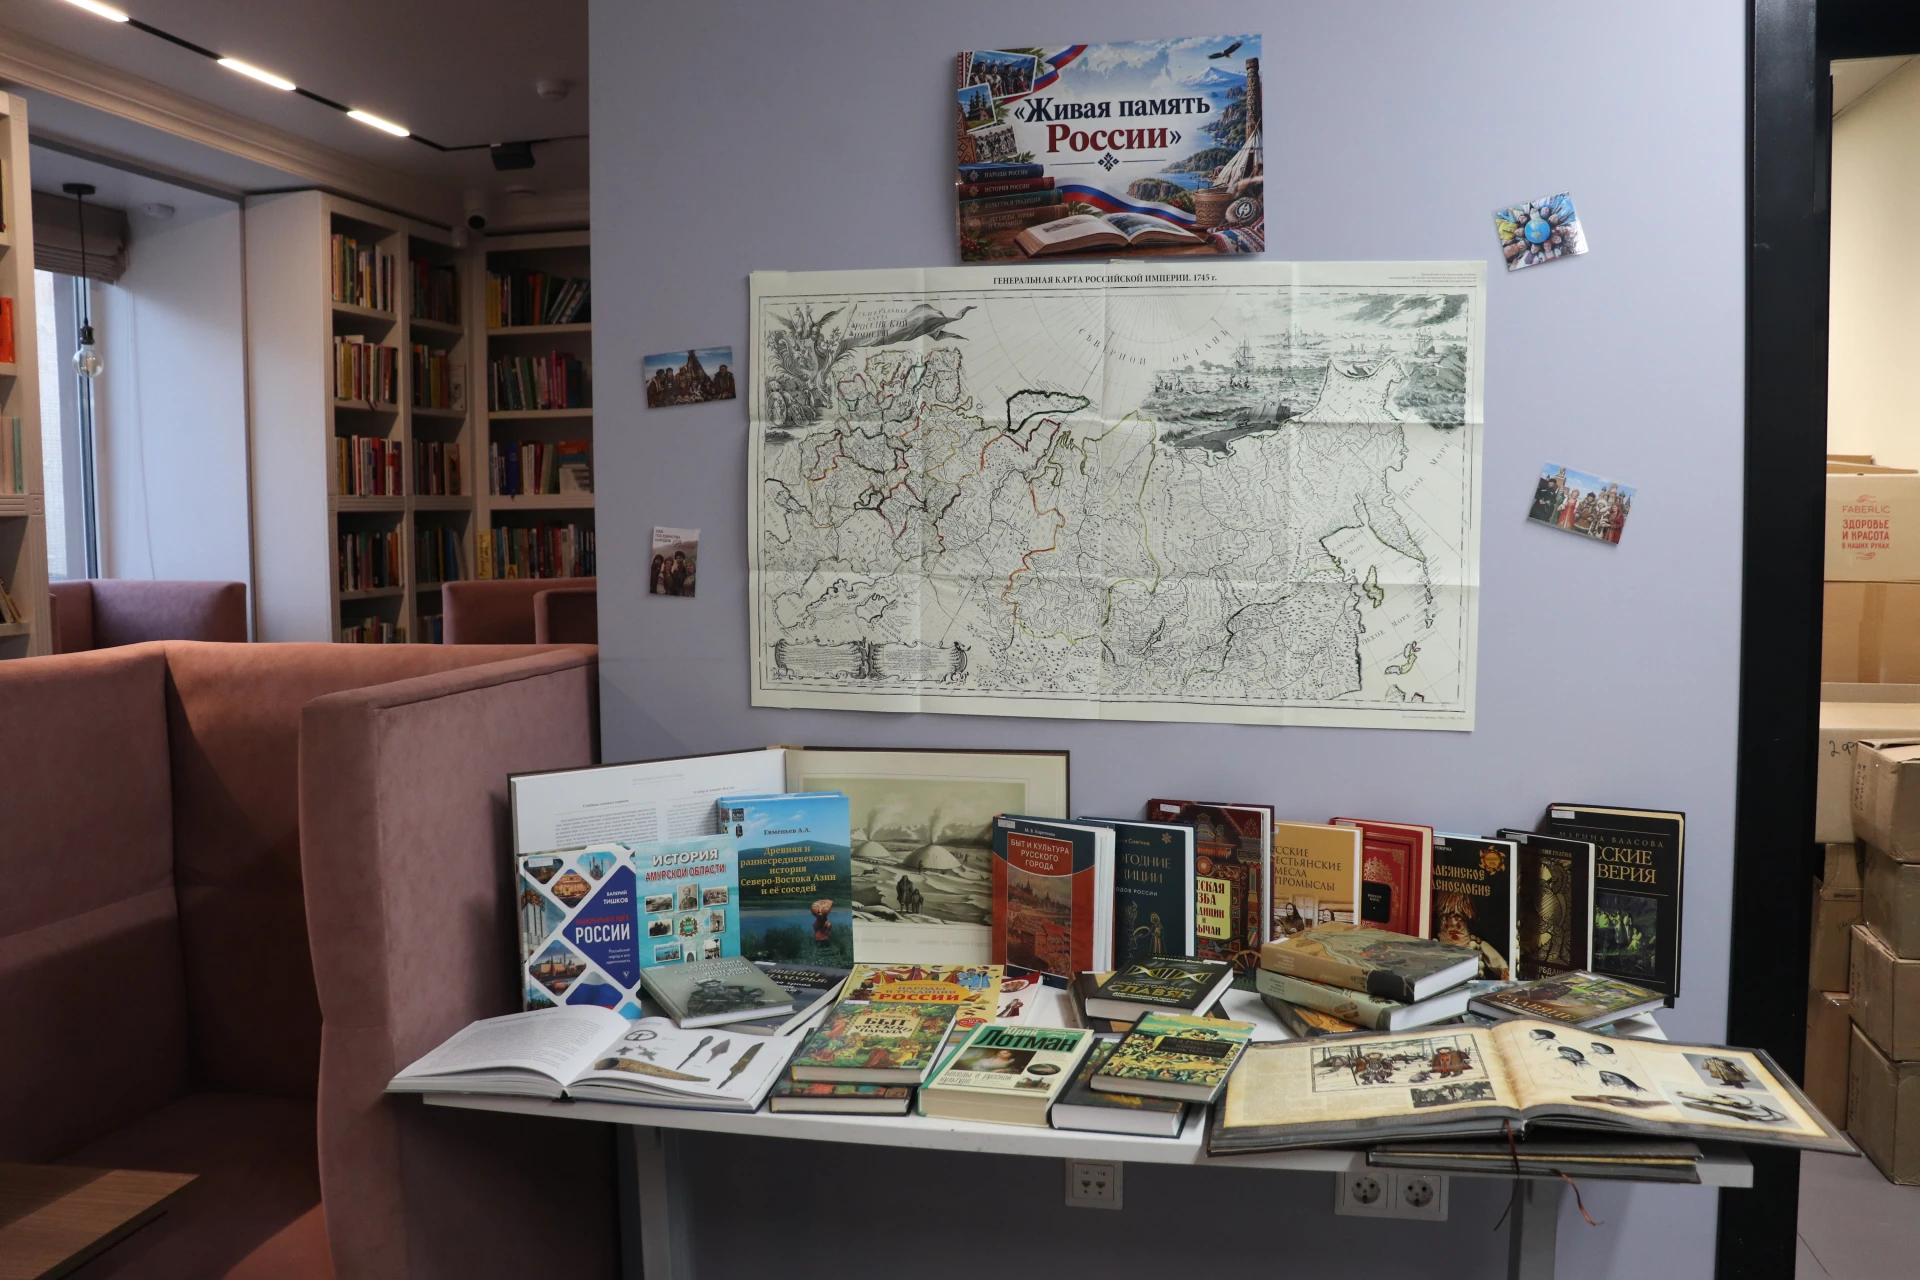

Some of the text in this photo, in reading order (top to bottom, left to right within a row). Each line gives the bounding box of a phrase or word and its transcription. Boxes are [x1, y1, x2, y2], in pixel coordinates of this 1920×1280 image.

[1014, 97, 1210, 122] «Живая память
[1046, 124, 1182, 153] России»
[993, 276, 1053, 285] ГЕНЕРАЛЬНАЯ
[1055, 276, 1083, 284] КАРТА
[1085, 274, 1143, 283] РОССИЙСКОЙ
[1145, 274, 1192, 283] ИМПЕРИИ.
[1193, 273, 1210, 282] 1745
[1842, 505, 1891, 514] FABERLIC
[1842, 519, 1889, 529] ЗДОРОВЬЕ
[1842, 531, 1890, 540] И КРАСОТА
[1010, 838, 1026, 848] БЫТ
[1033, 843, 1070, 855] КУЛЬТУРА
[1559, 832, 1664, 848] МАРИНА ВЛАСОВА
[652, 848, 719, 867] ИСТОРИЯ
[763, 846, 802, 856] Древняя
[1020, 850, 1058, 862] РУССКОГО
[1274, 845, 1309, 858] ССКИЕ
[1597, 846, 1652, 866] СКИЕ
[740, 854, 836, 868] раннесредневековая
[1025, 860, 1054, 871] ГОРОДА
[1276, 856, 1342, 872] ЕСТЬЯНСКИЕ
[645, 863, 726, 882] АМУРСКОЙ ОБЛАСТИ
[769, 866, 807, 875] история
[1274, 866, 1308, 878] МЕСЛА
[1433, 864, 1485, 880] АВЯНСКОЕ
[1597, 864, 1657, 884] ВЕРИЯ
[740, 874, 836, 887] Северо-Востока Азии
[1274, 876, 1335, 892] ПРОМЫСЛЫ
[781, 884, 816, 894] соседей
[1134, 888, 1158, 896] РОССИИ
[1432, 879, 1491, 896] СНОСЛОВИЕ
[603, 897, 629, 905] ТИШКОВ
[1196, 892, 1216, 906] ЗБА
[1196, 906, 1225, 918] ДИЦИИ
[575, 923, 630, 944] РОССИИ
[1196, 924, 1221, 936] ЫЧАИ
[1107, 984, 1194, 1000] СЛАВЯН
[864, 1018, 911, 1026] БЫТ
[1004, 1026, 1040, 1036] Юрий
[974, 1030, 1078, 1052] Лотман
